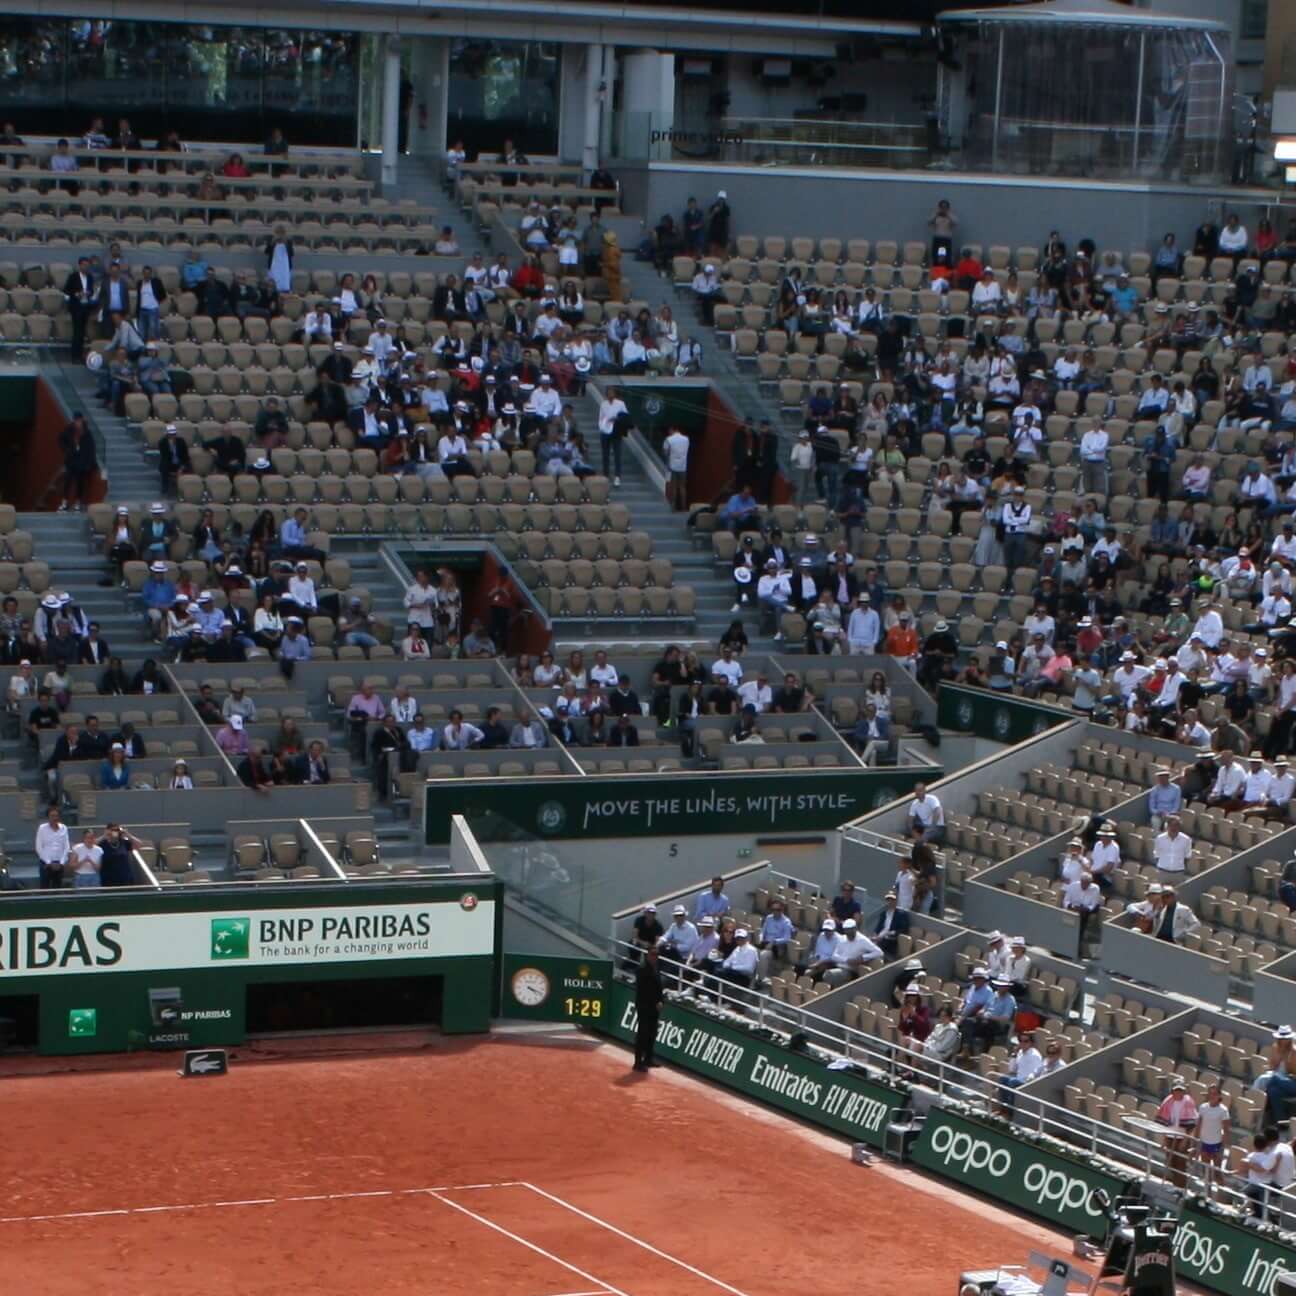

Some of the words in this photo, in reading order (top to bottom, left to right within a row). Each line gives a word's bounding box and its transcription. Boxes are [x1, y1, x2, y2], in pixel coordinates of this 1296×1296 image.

[583, 801, 640, 830] MOVE
[646, 799, 680, 827] THE
[686, 788, 742, 816] LINES,
[747, 794, 792, 823] WITH
[797, 793, 856, 810] STYLE
[260, 919, 314, 943] BNP
[321, 912, 431, 940] PARIBAS
[260, 946, 280, 957] The
[284, 944, 310, 956] bank
[313, 943, 330, 957] for
[334, 945, 340, 954] a
[344, 940, 393, 955] changing
[397, 938, 429, 951] world
[563, 977, 604, 990] ROLEX
[181, 1011, 194, 1020] NP
[195, 1009, 231, 1020] PARIBAS
[565, 998, 601, 1018] 1:29
[149, 1033, 190, 1043] LACOSTE
[702, 1036, 744, 1074] BETTER
[750, 1053, 822, 1107] Emirates
[844, 1092, 888, 1132] BETTER
[931, 1125, 1011, 1177] oppo
[1134, 1250, 1170, 1278] perrier
